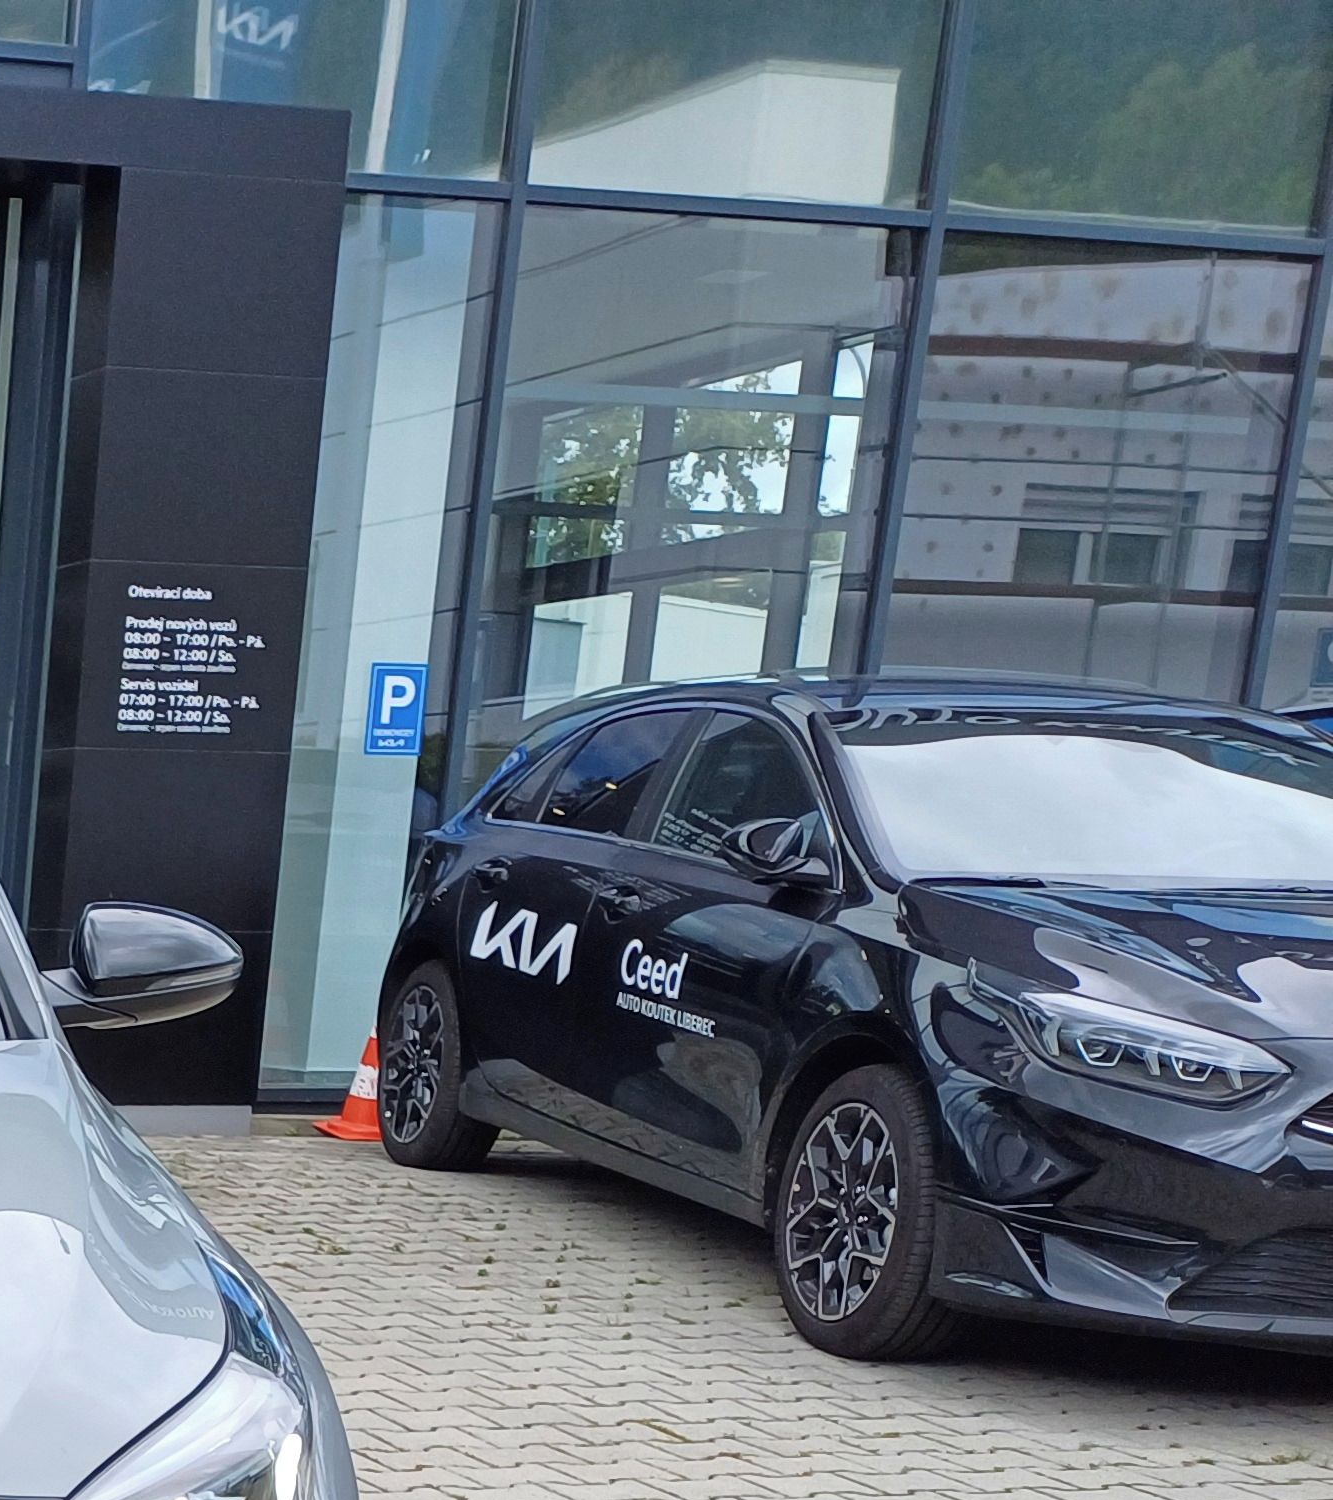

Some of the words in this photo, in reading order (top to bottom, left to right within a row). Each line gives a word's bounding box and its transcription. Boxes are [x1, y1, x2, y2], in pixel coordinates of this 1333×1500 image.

[182, 588, 213, 600] doba
[125, 616, 165, 632] Prodej
[176, 633, 209, 646] 17:00
[173, 648, 208, 661] 12:00
[120, 677, 155, 691] Servis
[119, 693, 156, 706] 07:00
[169, 694, 204, 707] 17:00
[380, 675, 416, 725] P
[470, 901, 578, 985] KIA
[620, 939, 688, 1000] Ceed
[616, 992, 641, 1013] AUTO
[641, 998, 677, 1025] KOUTEK
[677, 1010, 716, 1038] LIBEREC
